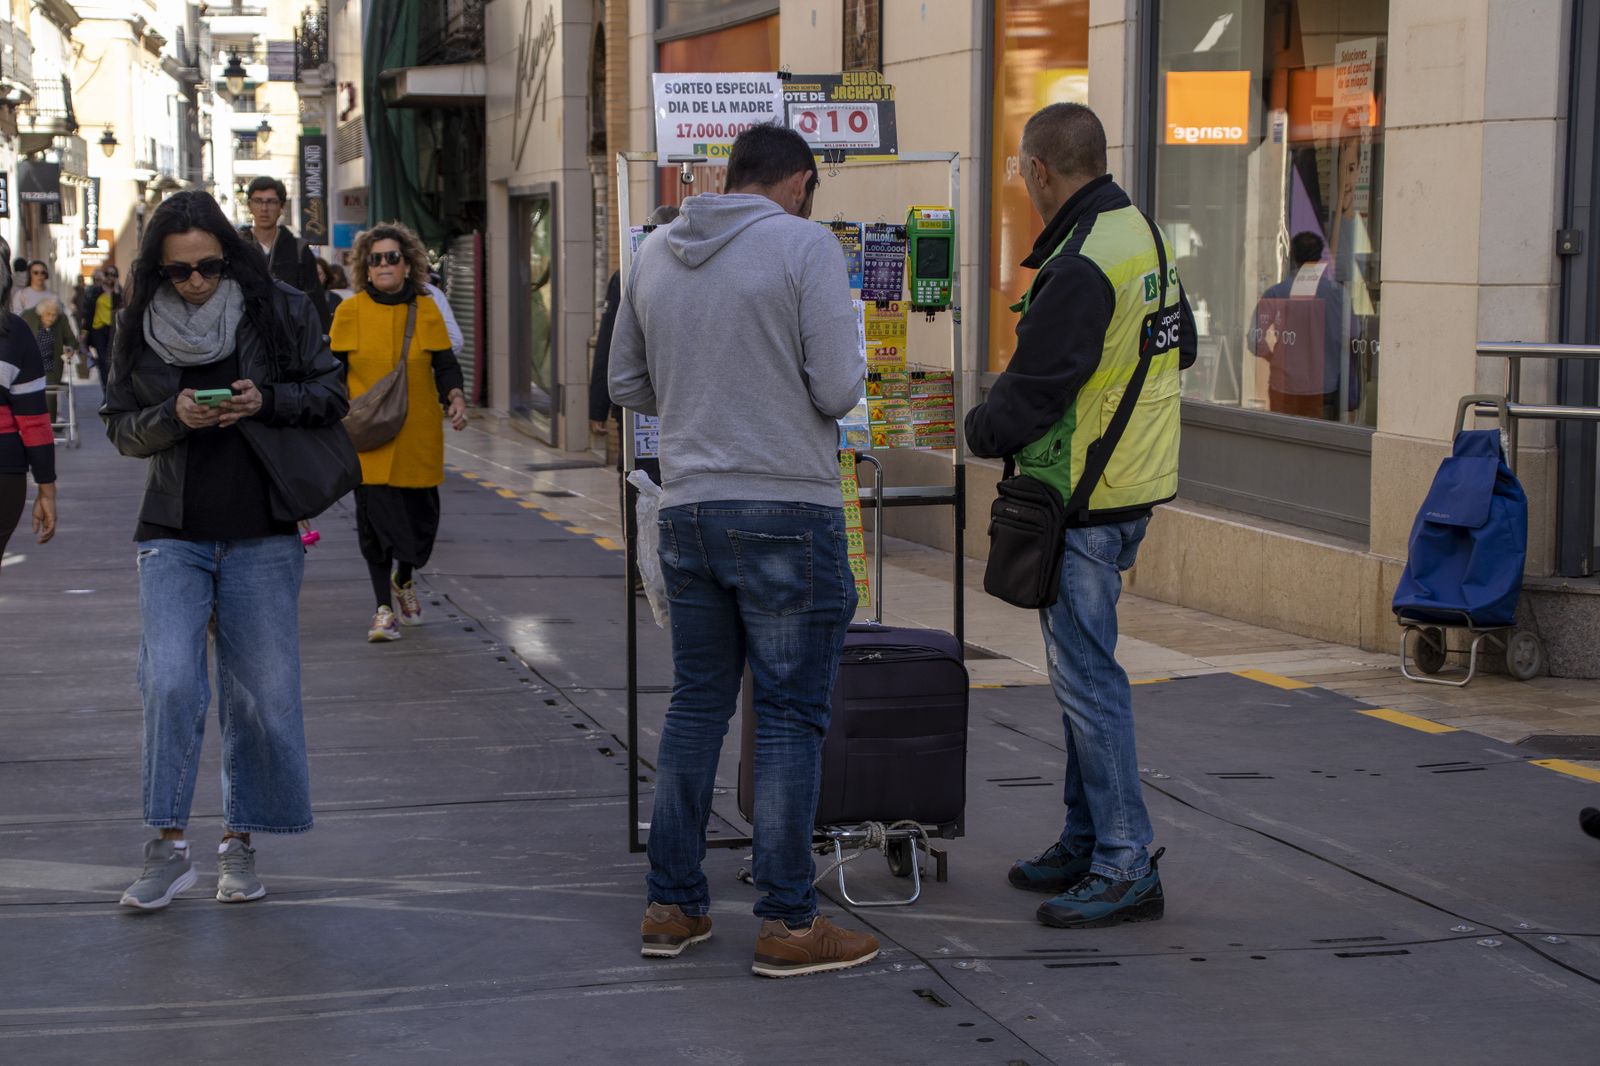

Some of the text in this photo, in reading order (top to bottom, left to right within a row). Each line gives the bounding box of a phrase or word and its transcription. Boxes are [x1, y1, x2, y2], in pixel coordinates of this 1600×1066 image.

[664, 82, 774, 95] SORTEO ESPECIAL
[831, 84, 893, 100] JACKPOT
[783, 92, 826, 101] OTE DE
[668, 101, 774, 113] DIA DE LA MADRE
[304, 145, 322, 197] MOMENTO
